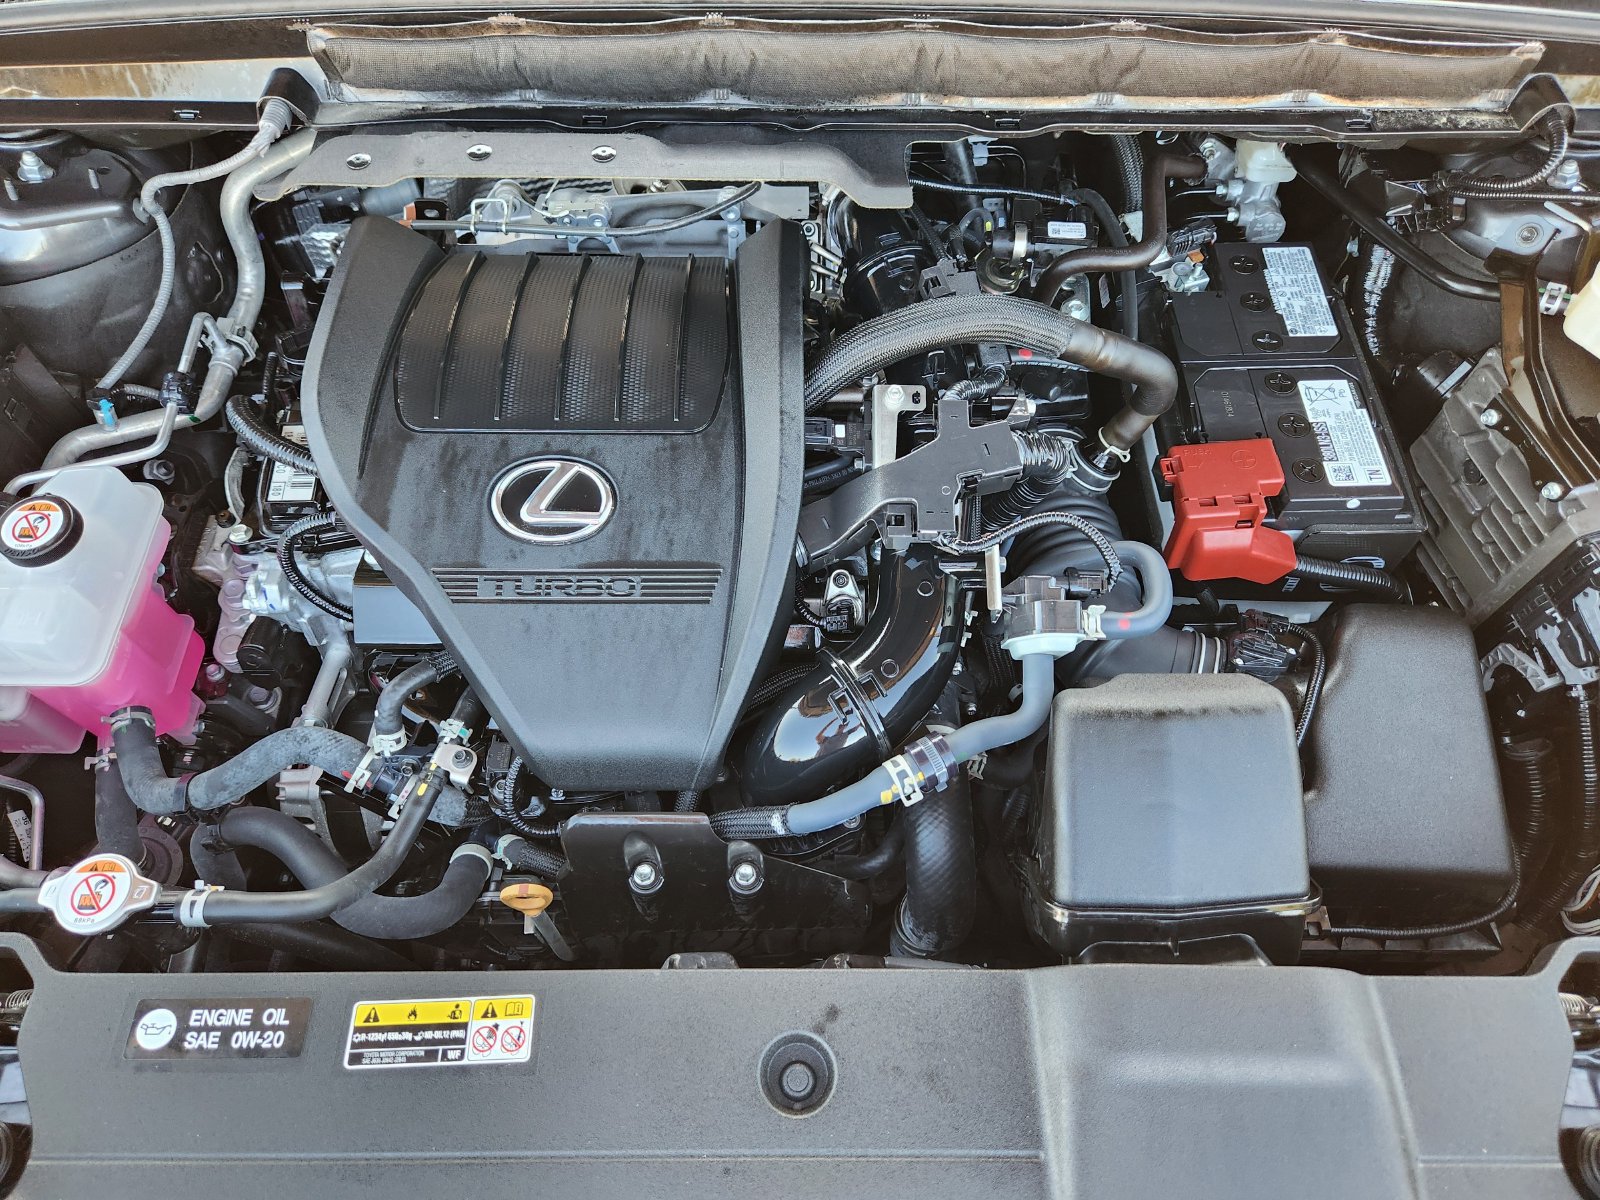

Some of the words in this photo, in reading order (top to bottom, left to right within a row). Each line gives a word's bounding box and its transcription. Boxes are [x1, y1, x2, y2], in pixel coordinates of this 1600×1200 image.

[1338, 388, 1347, 398] Pb
[1367, 469, 1384, 482] TN
[482, 575, 638, 597] TURBO
[189, 1008, 254, 1027] ENGINE
[262, 1008, 290, 1026] OIL
[184, 1031, 220, 1049] SAE
[230, 1031, 285, 1048] 0W-20
[447, 1049, 462, 1060] WF
